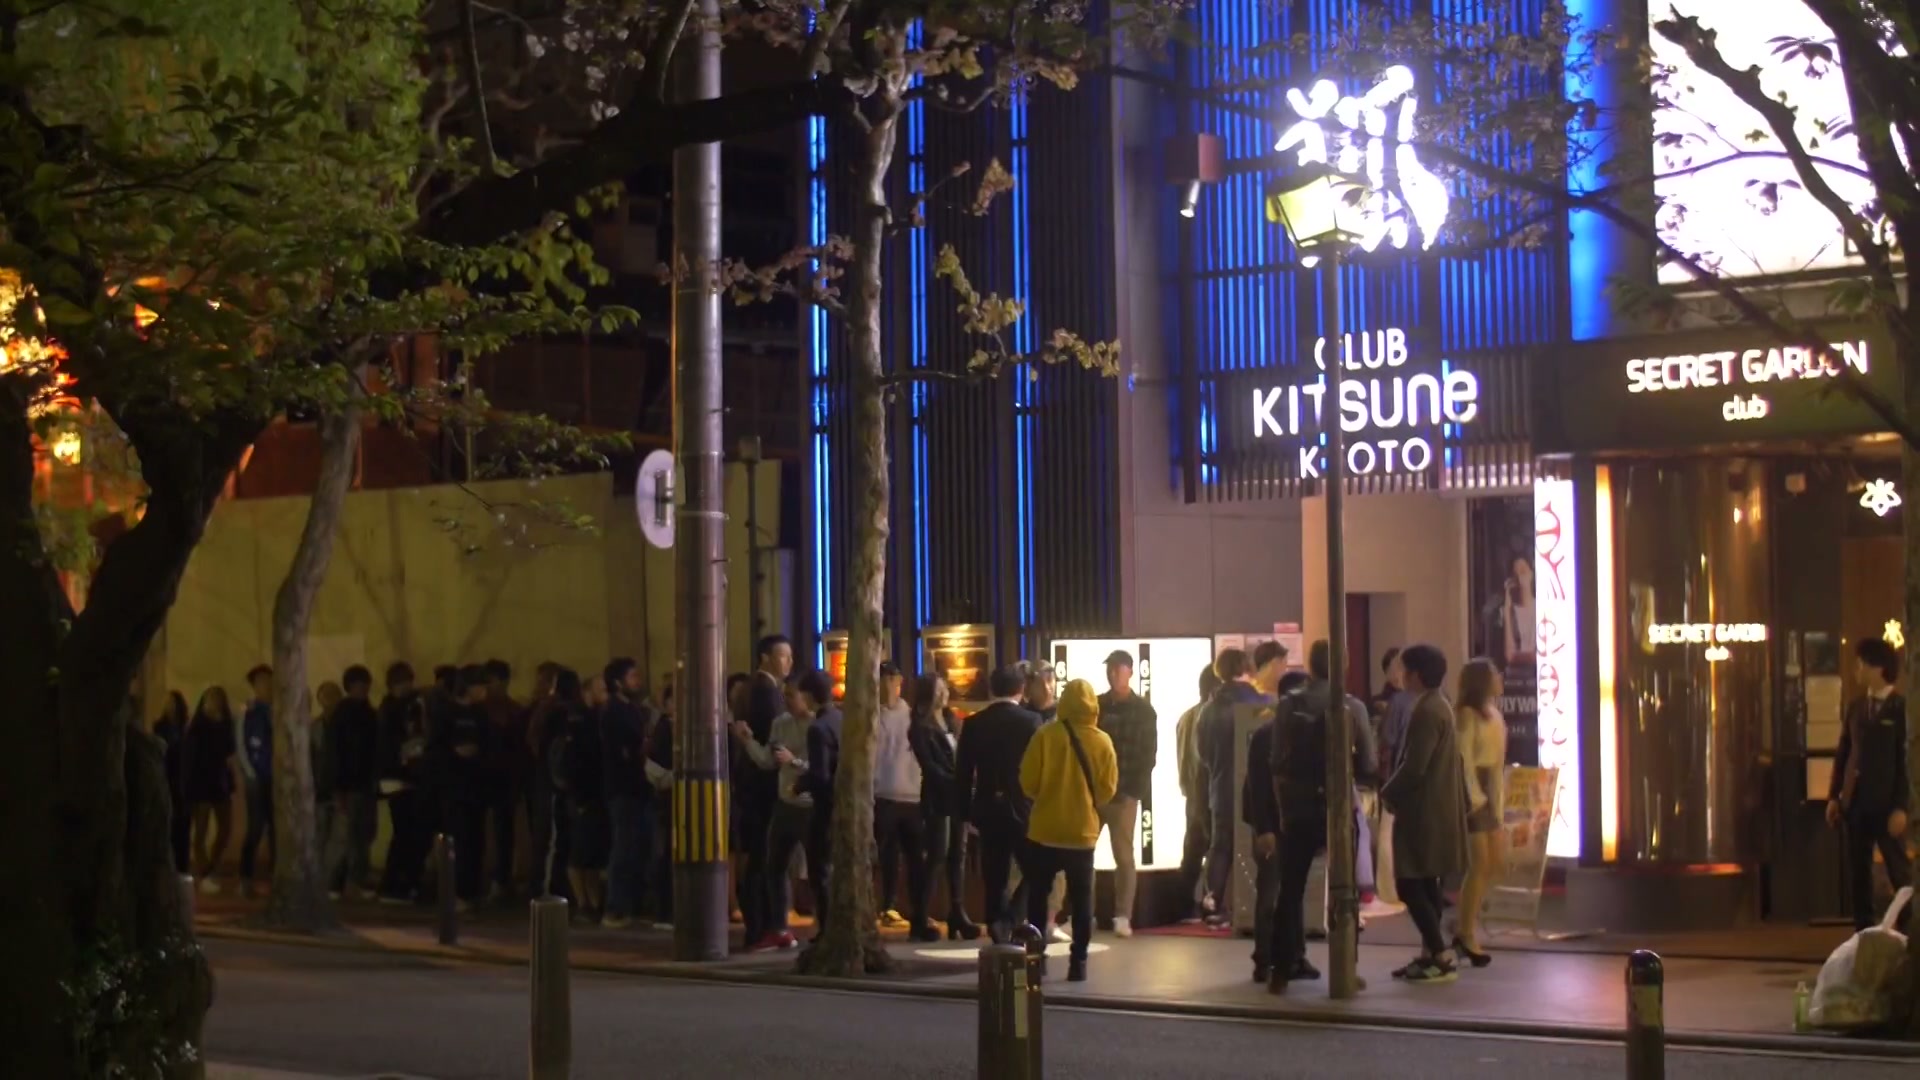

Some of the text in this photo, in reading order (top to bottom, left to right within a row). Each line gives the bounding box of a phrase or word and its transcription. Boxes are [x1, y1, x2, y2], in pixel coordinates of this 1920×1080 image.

[1314, 328, 1408, 370] CLUB
[1626, 352, 1737, 392] SECRET
[1723, 395, 1768, 421] club
[1299, 437, 1430, 479] KOTO
[1142, 810, 1152, 848] 3F
